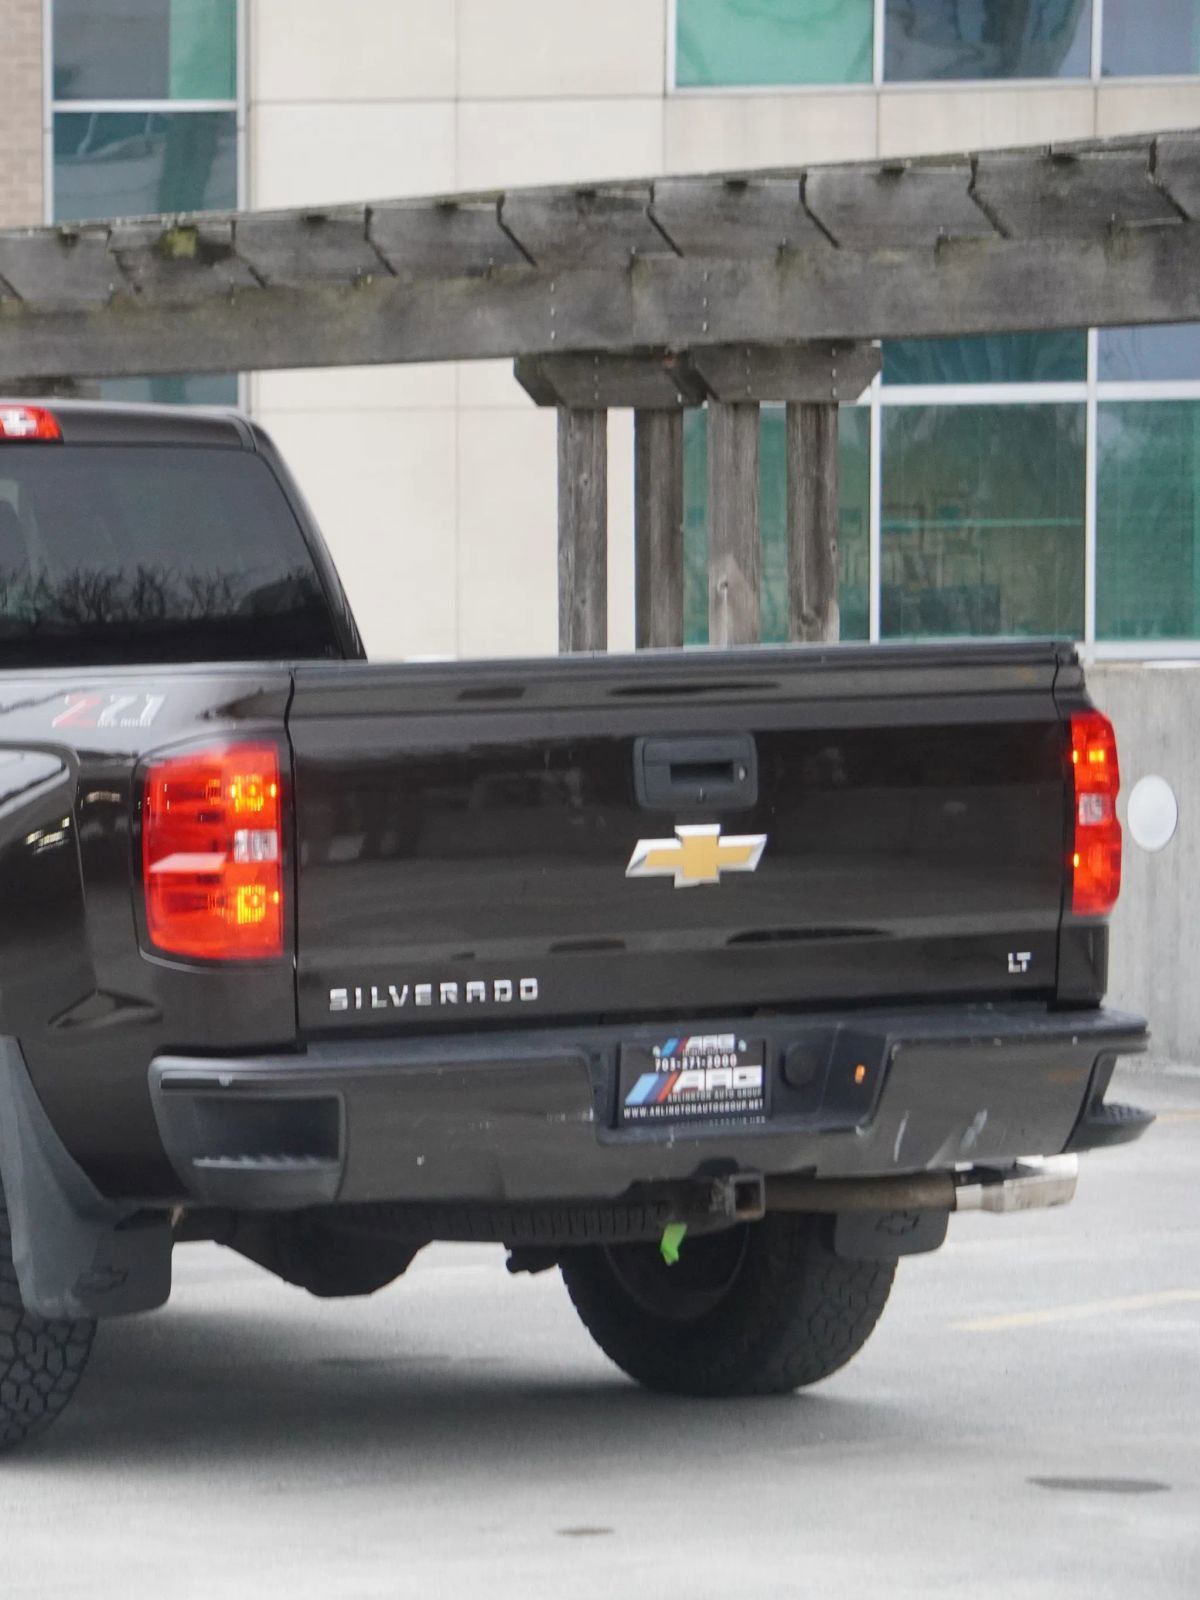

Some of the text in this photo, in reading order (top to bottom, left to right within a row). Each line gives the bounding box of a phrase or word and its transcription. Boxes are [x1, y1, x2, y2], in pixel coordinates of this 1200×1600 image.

[52, 694, 166, 728] Z71
[1008, 952, 1031, 973] LT
[329, 978, 538, 1011] SILVERADO
[714, 1088, 735, 1100] AUTO
